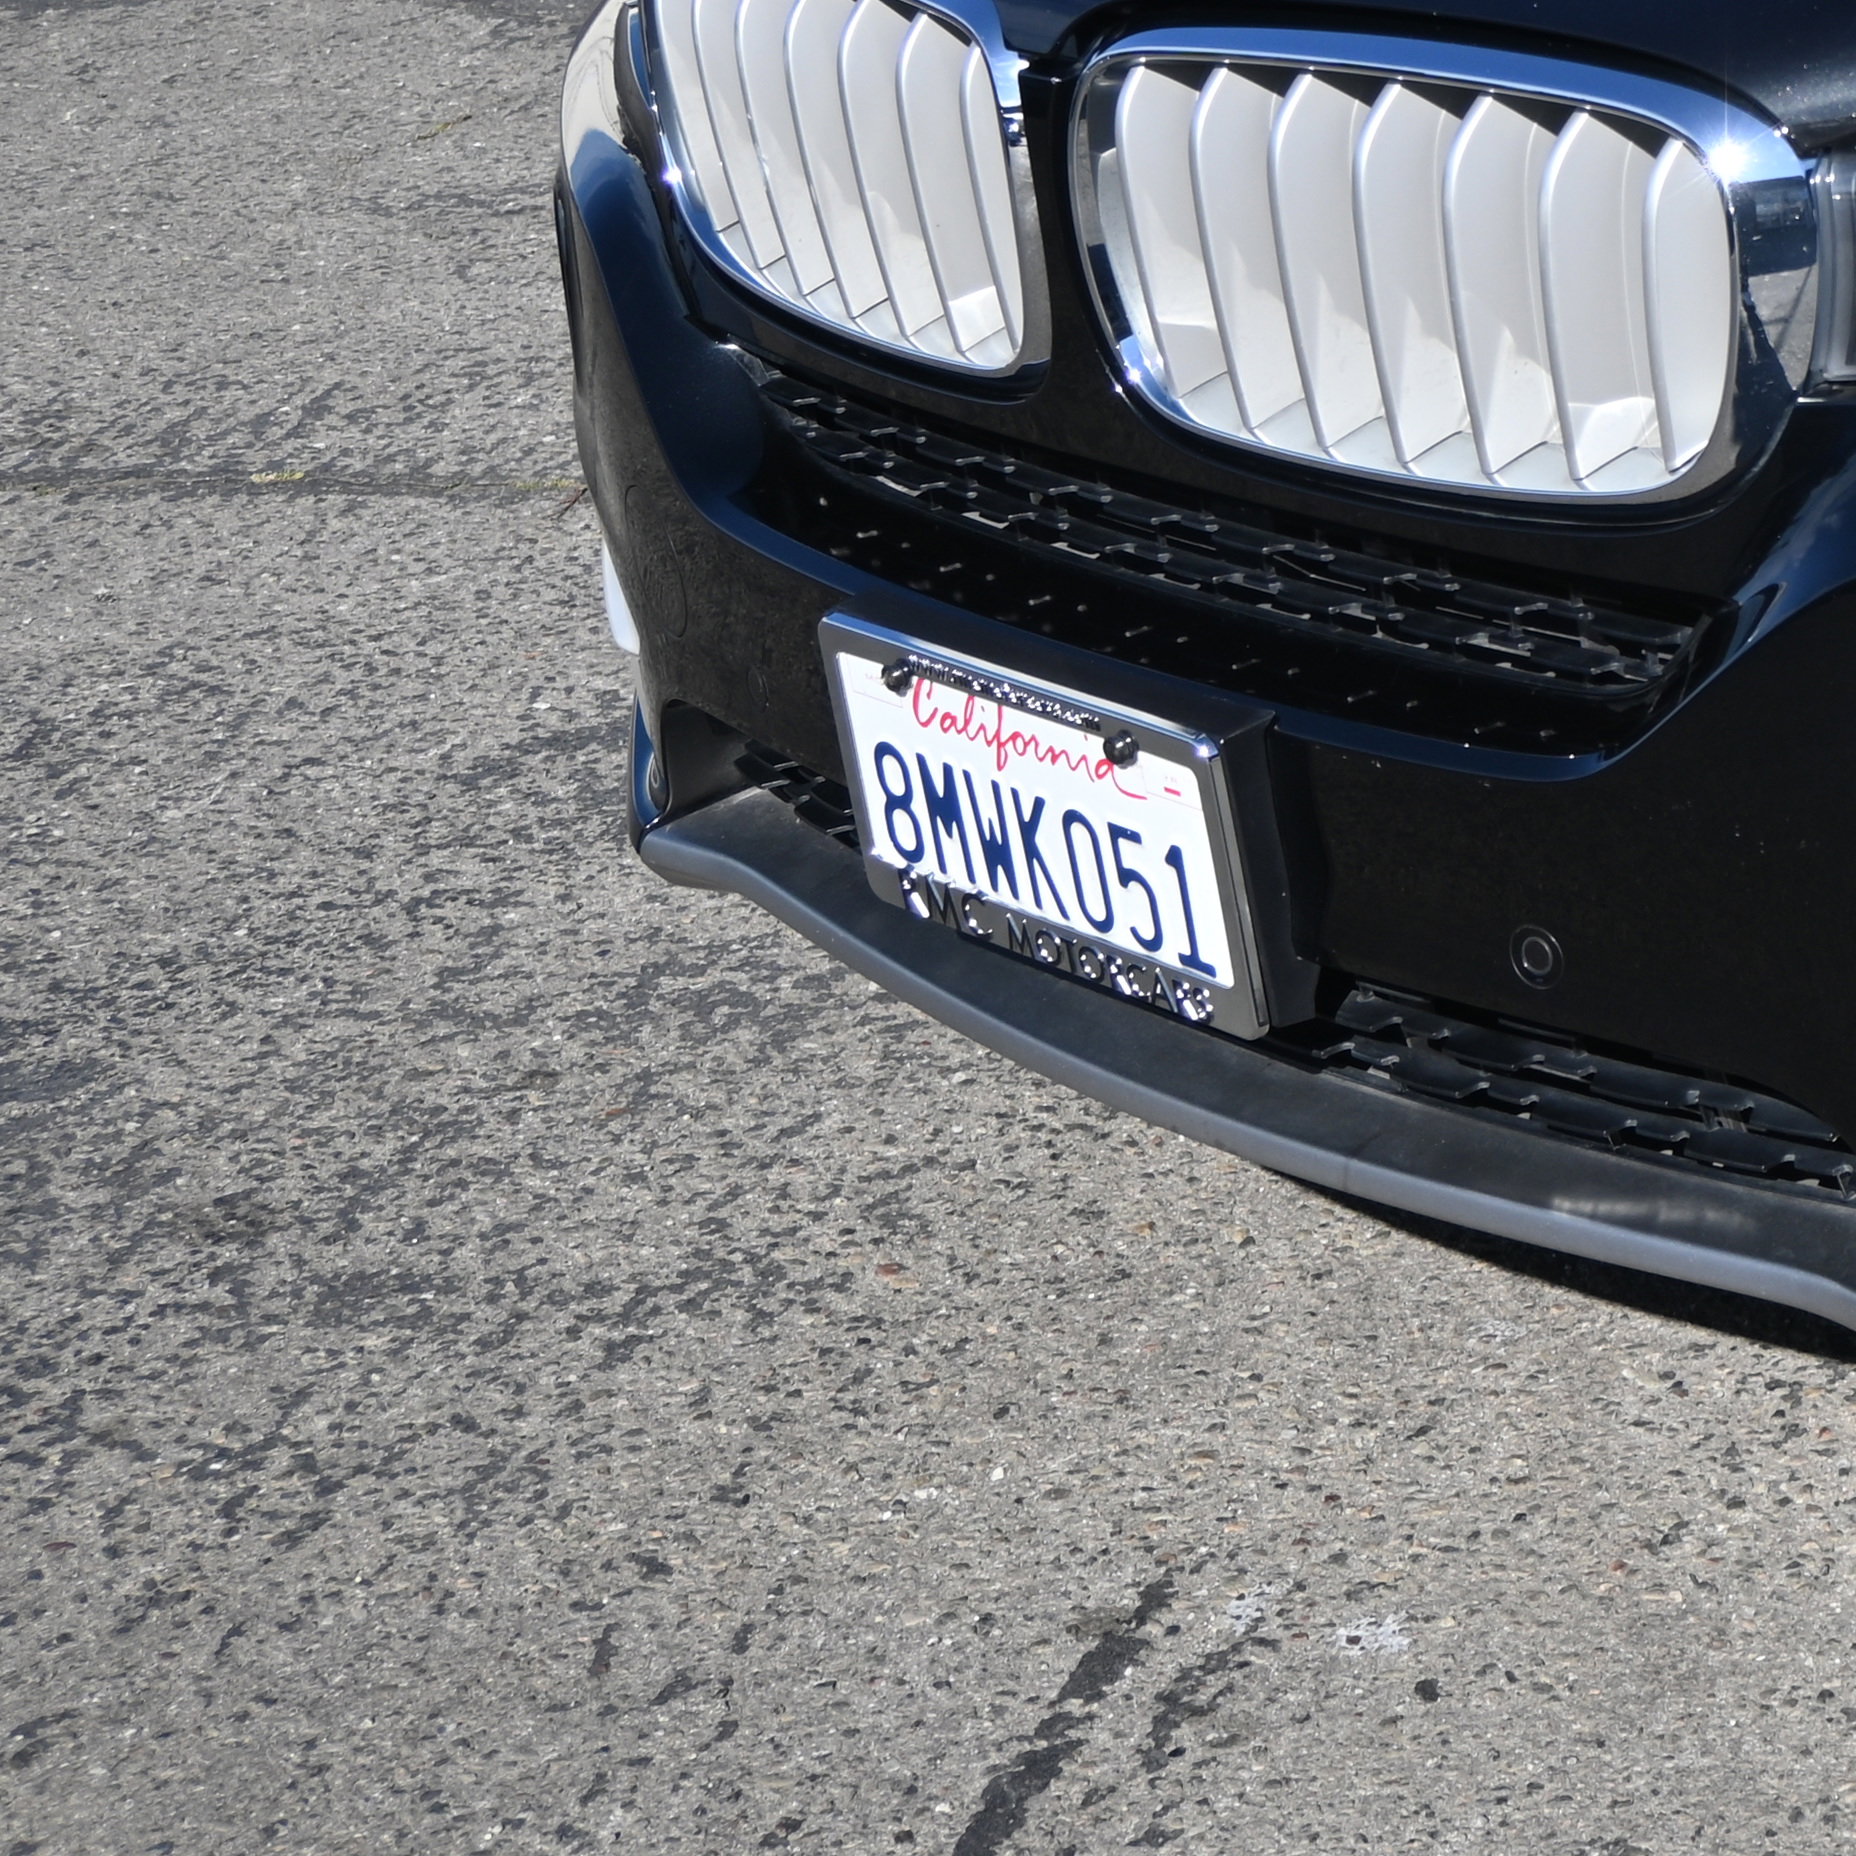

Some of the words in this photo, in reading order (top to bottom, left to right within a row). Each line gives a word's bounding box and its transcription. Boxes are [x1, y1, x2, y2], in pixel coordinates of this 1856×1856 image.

[912, 677, 1148, 800] California
[873, 740, 1217, 979] 8MWK051
[899, 870, 994, 938] RMC
[1006, 911, 1215, 1025] MOTORCARS
